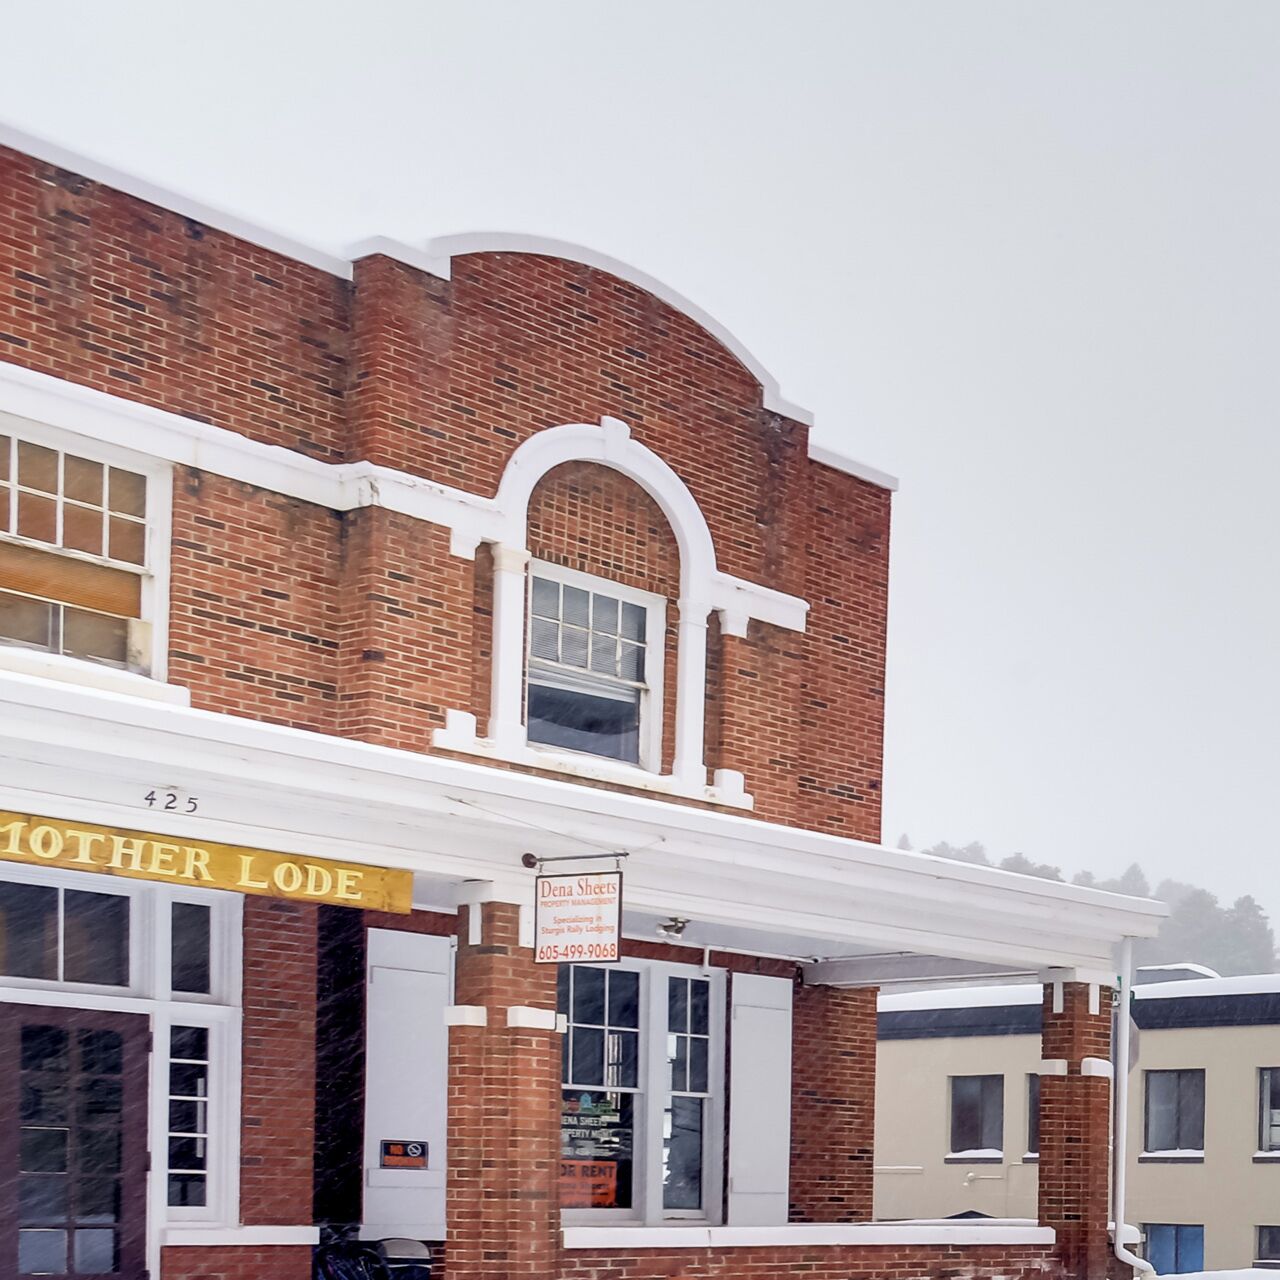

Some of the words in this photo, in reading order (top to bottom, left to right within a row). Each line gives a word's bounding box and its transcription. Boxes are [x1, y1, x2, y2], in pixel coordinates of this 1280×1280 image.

[144, 790, 199, 813] 425
[236, 855, 363, 900] LODE
[541, 880, 573, 898] Dena
[576, 877, 617, 896] Sheets
[539, 942, 617, 960] 605-499-9068
[562, 1115, 578, 1125] ENA
[561, 1163, 576, 1178] OR
[581, 1164, 615, 1178] RENT
